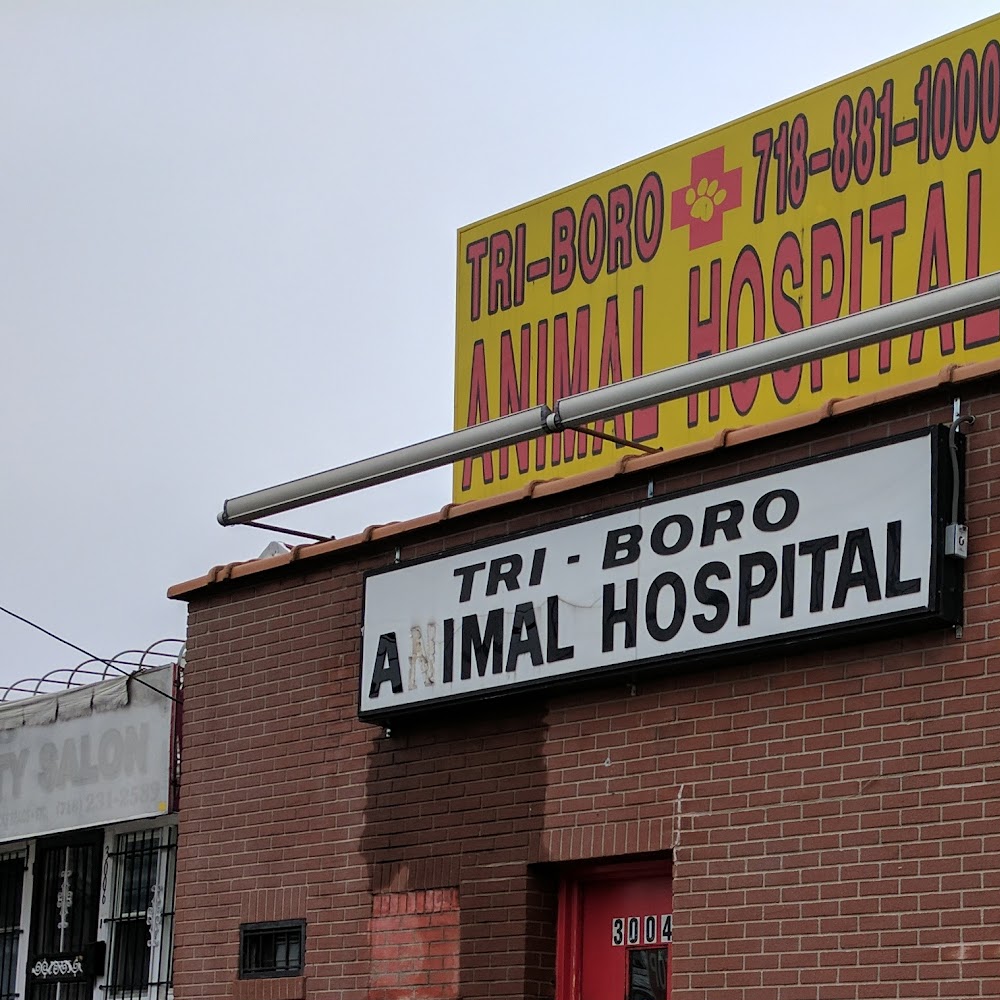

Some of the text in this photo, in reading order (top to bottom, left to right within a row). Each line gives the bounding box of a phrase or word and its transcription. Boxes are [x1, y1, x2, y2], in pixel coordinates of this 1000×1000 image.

[466, 170, 664, 322] TRI-BORO
[461, 284, 660, 492] ANIMAL
[369, 520, 922, 699] ANIMAL HOSPITAL
[38, 722, 149, 794] SALON
[613, 915, 672, 945] 3004
